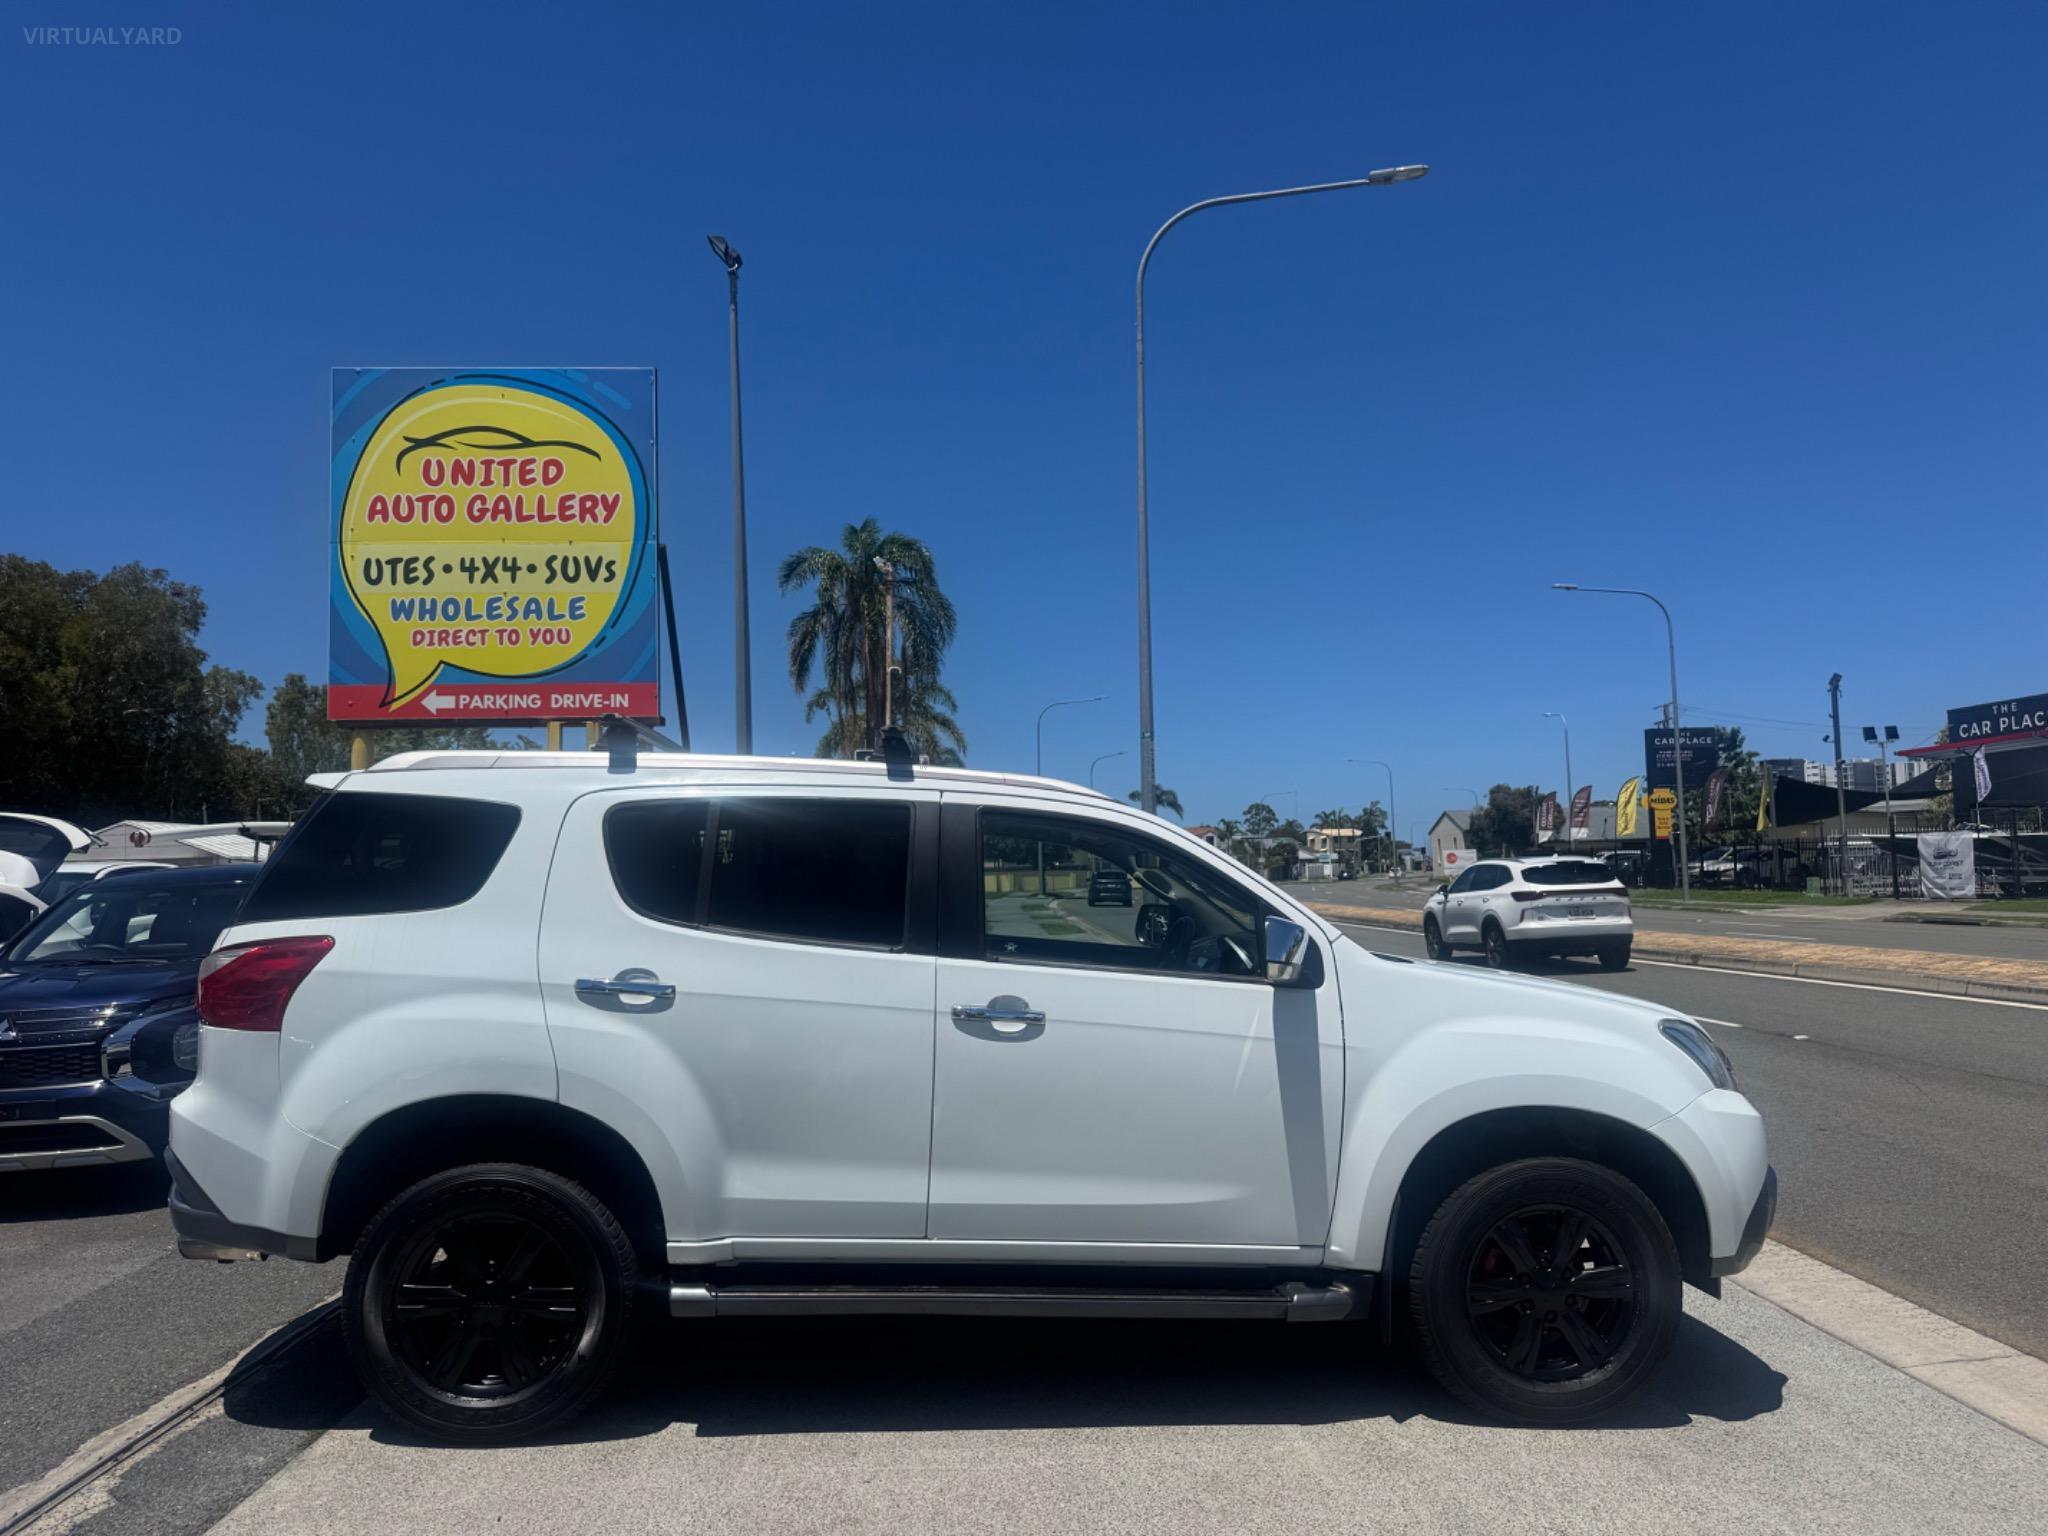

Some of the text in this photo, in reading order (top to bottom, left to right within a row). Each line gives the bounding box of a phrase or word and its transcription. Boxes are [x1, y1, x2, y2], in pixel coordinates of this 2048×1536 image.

[421, 457, 565, 487] UNITED
[367, 492, 622, 525] AUTO GALLERY
[363, 555, 617, 586] UTES 4X4 SUVs
[390, 595, 587, 622] WHOLESALE
[411, 627, 572, 648] DIRECT TO YOU
[459, 693, 629, 709] PARKING DRIVE-IN
[1992, 702, 2018, 715] THE
[1959, 711, 2048, 738] CAR PLAC
[1654, 736, 1713, 745] CAR PLACE
